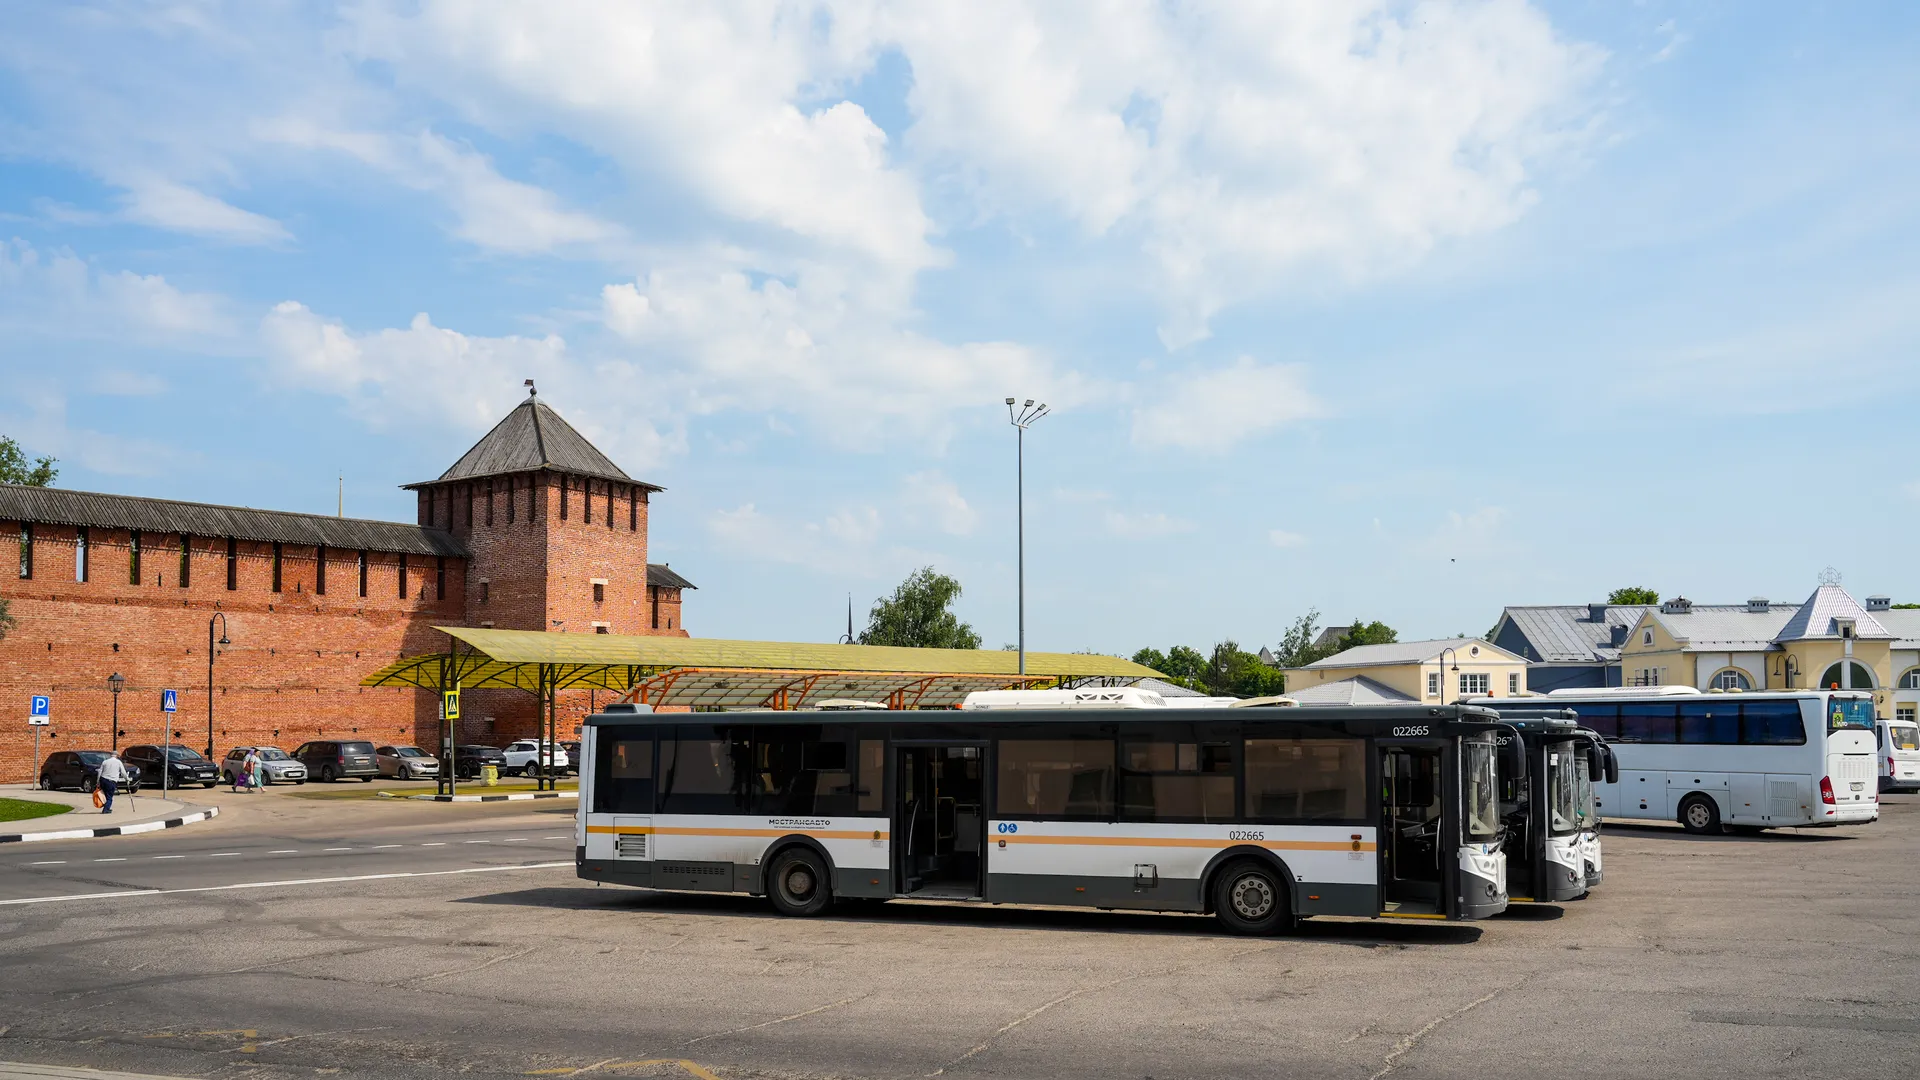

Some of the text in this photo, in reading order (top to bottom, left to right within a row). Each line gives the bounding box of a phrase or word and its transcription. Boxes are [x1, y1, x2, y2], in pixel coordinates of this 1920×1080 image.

[36, 698, 46, 714] P
[1393, 725, 1429, 736] 022665
[1229, 830, 1265, 841] 022665
